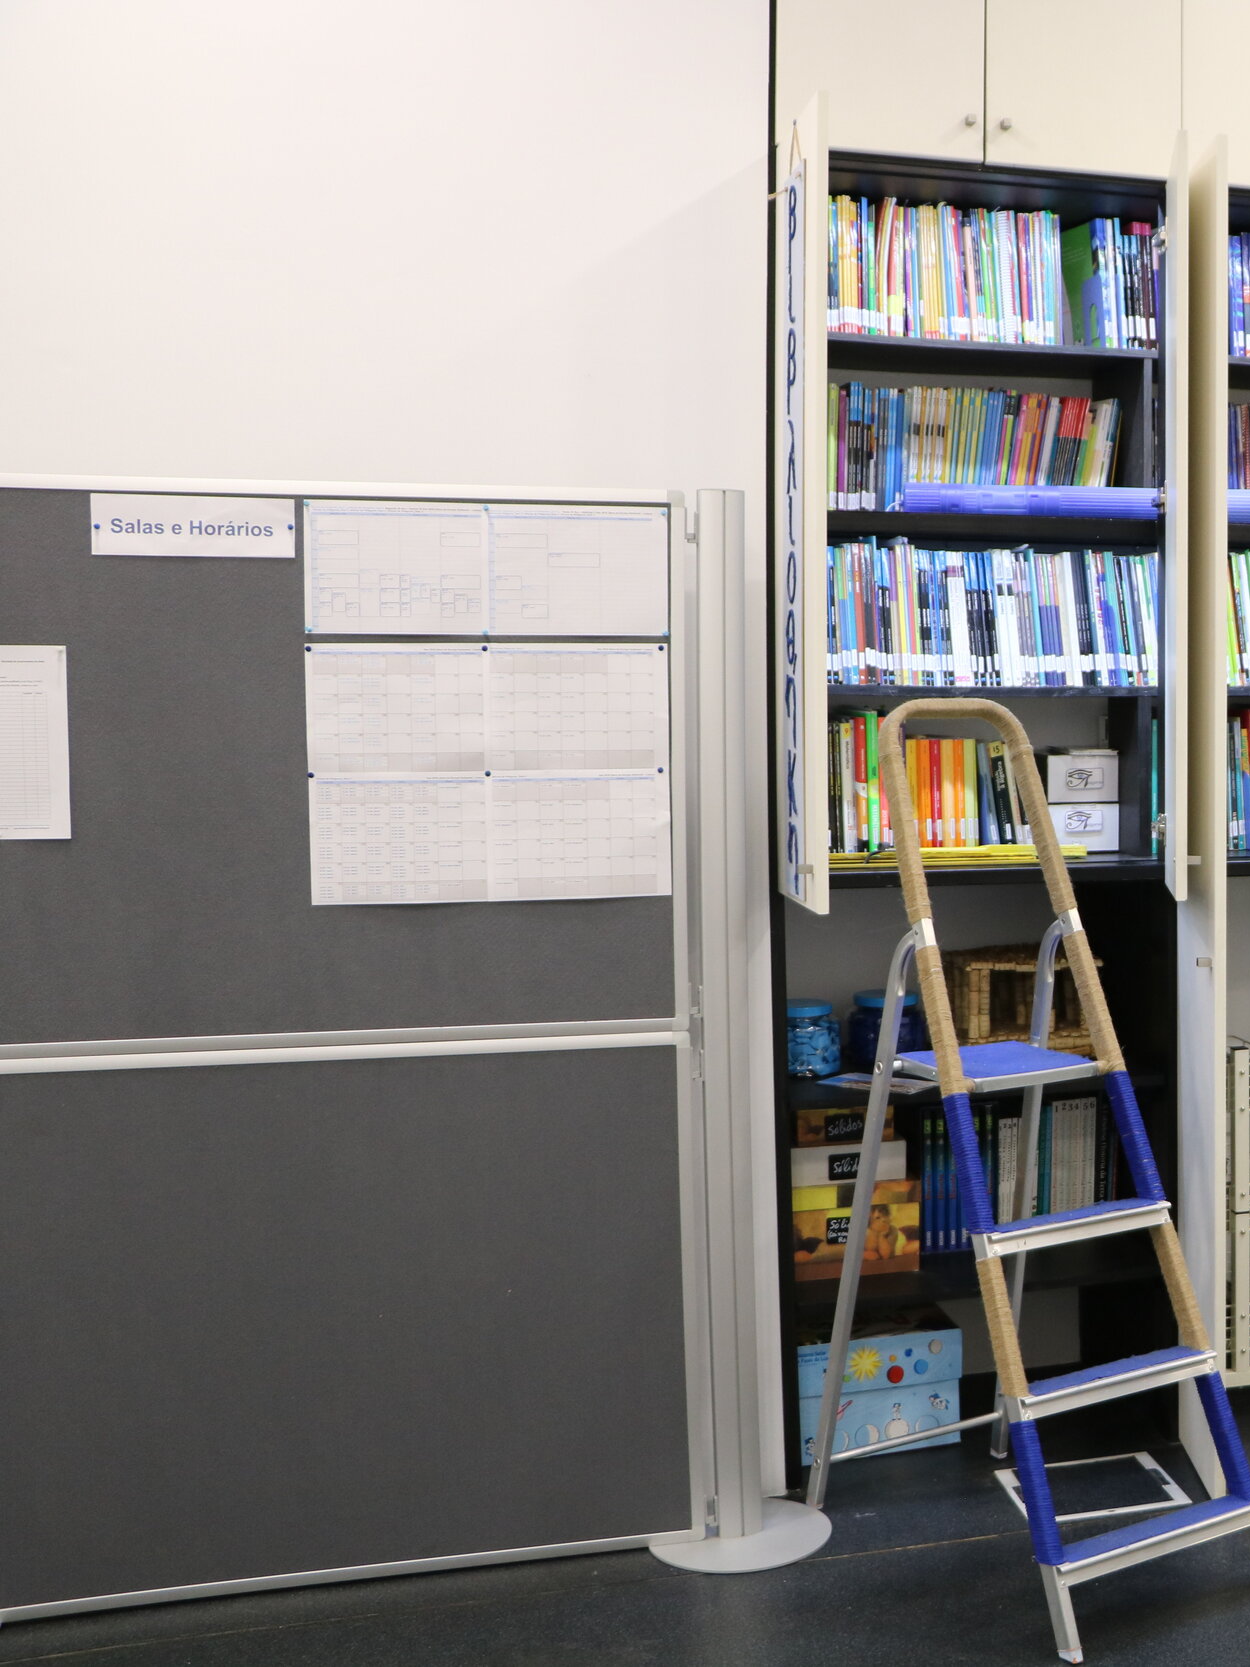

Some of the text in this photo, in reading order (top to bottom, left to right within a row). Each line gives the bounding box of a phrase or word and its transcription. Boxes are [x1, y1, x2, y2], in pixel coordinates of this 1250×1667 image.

[110, 518, 274, 537] Salas e Horários
[827, 1118, 863, 1136] Sólidos
[833, 1157, 859, 1173] Sólid
[829, 1218, 849, 1229] Sóli
